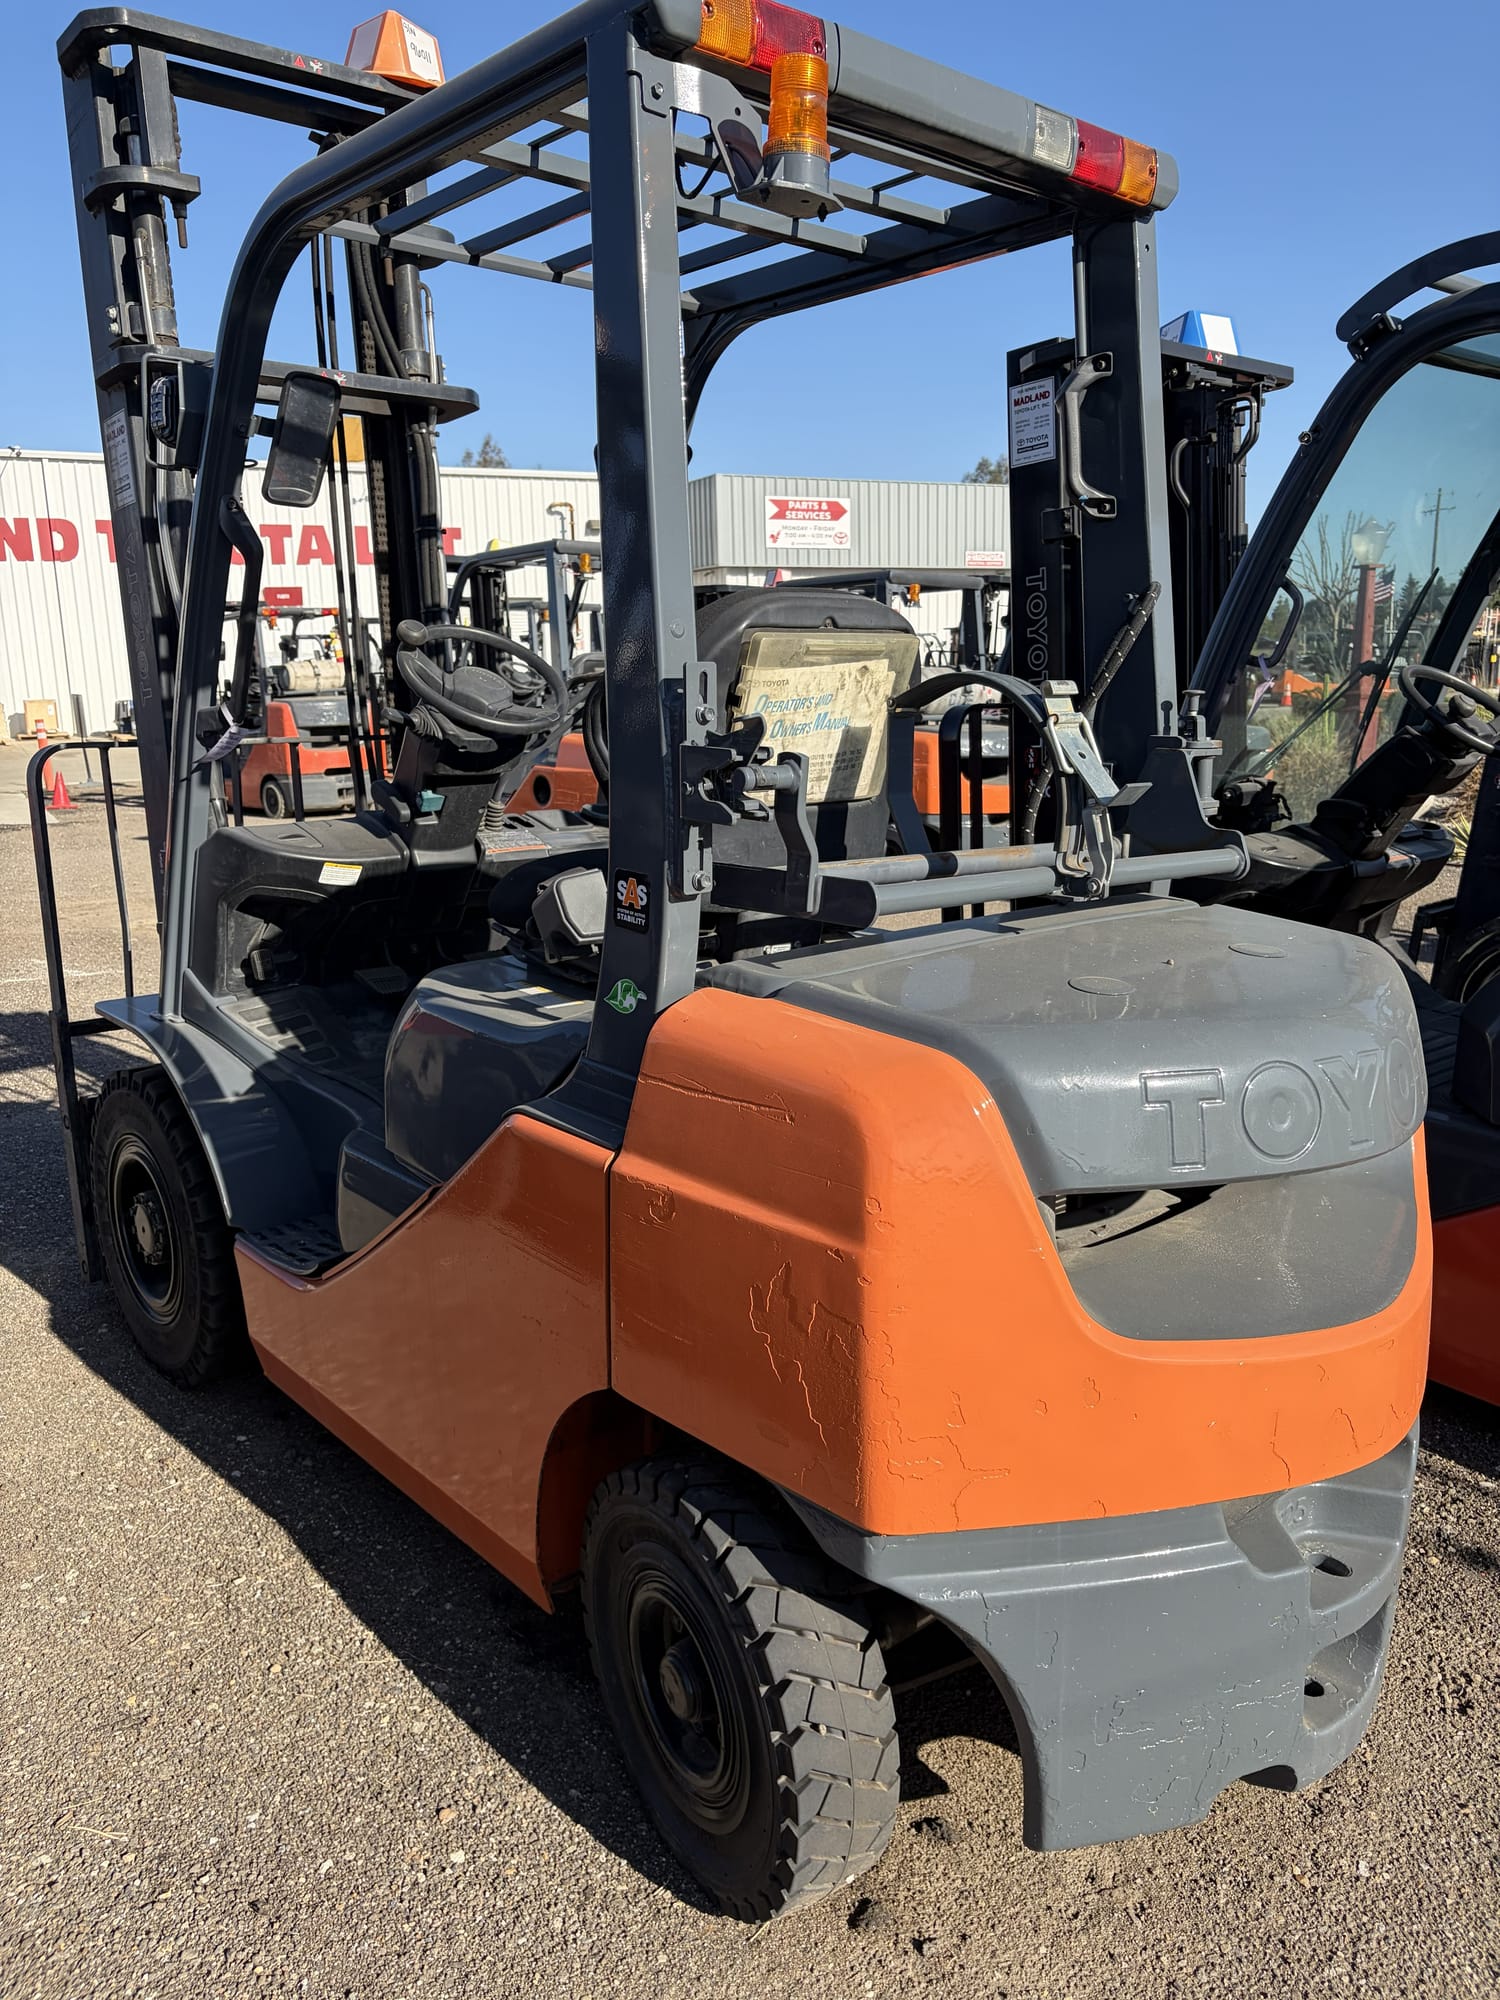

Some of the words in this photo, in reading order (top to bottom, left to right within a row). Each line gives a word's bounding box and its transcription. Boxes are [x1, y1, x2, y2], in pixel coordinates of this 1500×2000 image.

[1013, 391, 1050, 407] MADLAND
[1026, 434, 1048, 444] TOYOTA
[788, 501, 819, 510] PARTS
[821, 502, 828, 510] &
[785, 511, 831, 519] SERVICES
[1026, 567, 1049, 690] TOYOT
[762, 679, 789, 688] TOYOTA
[754, 693, 815, 714] OPERATOR'S
[616, 877, 647, 909] SAS
[616, 912, 646, 926] STABILITY
